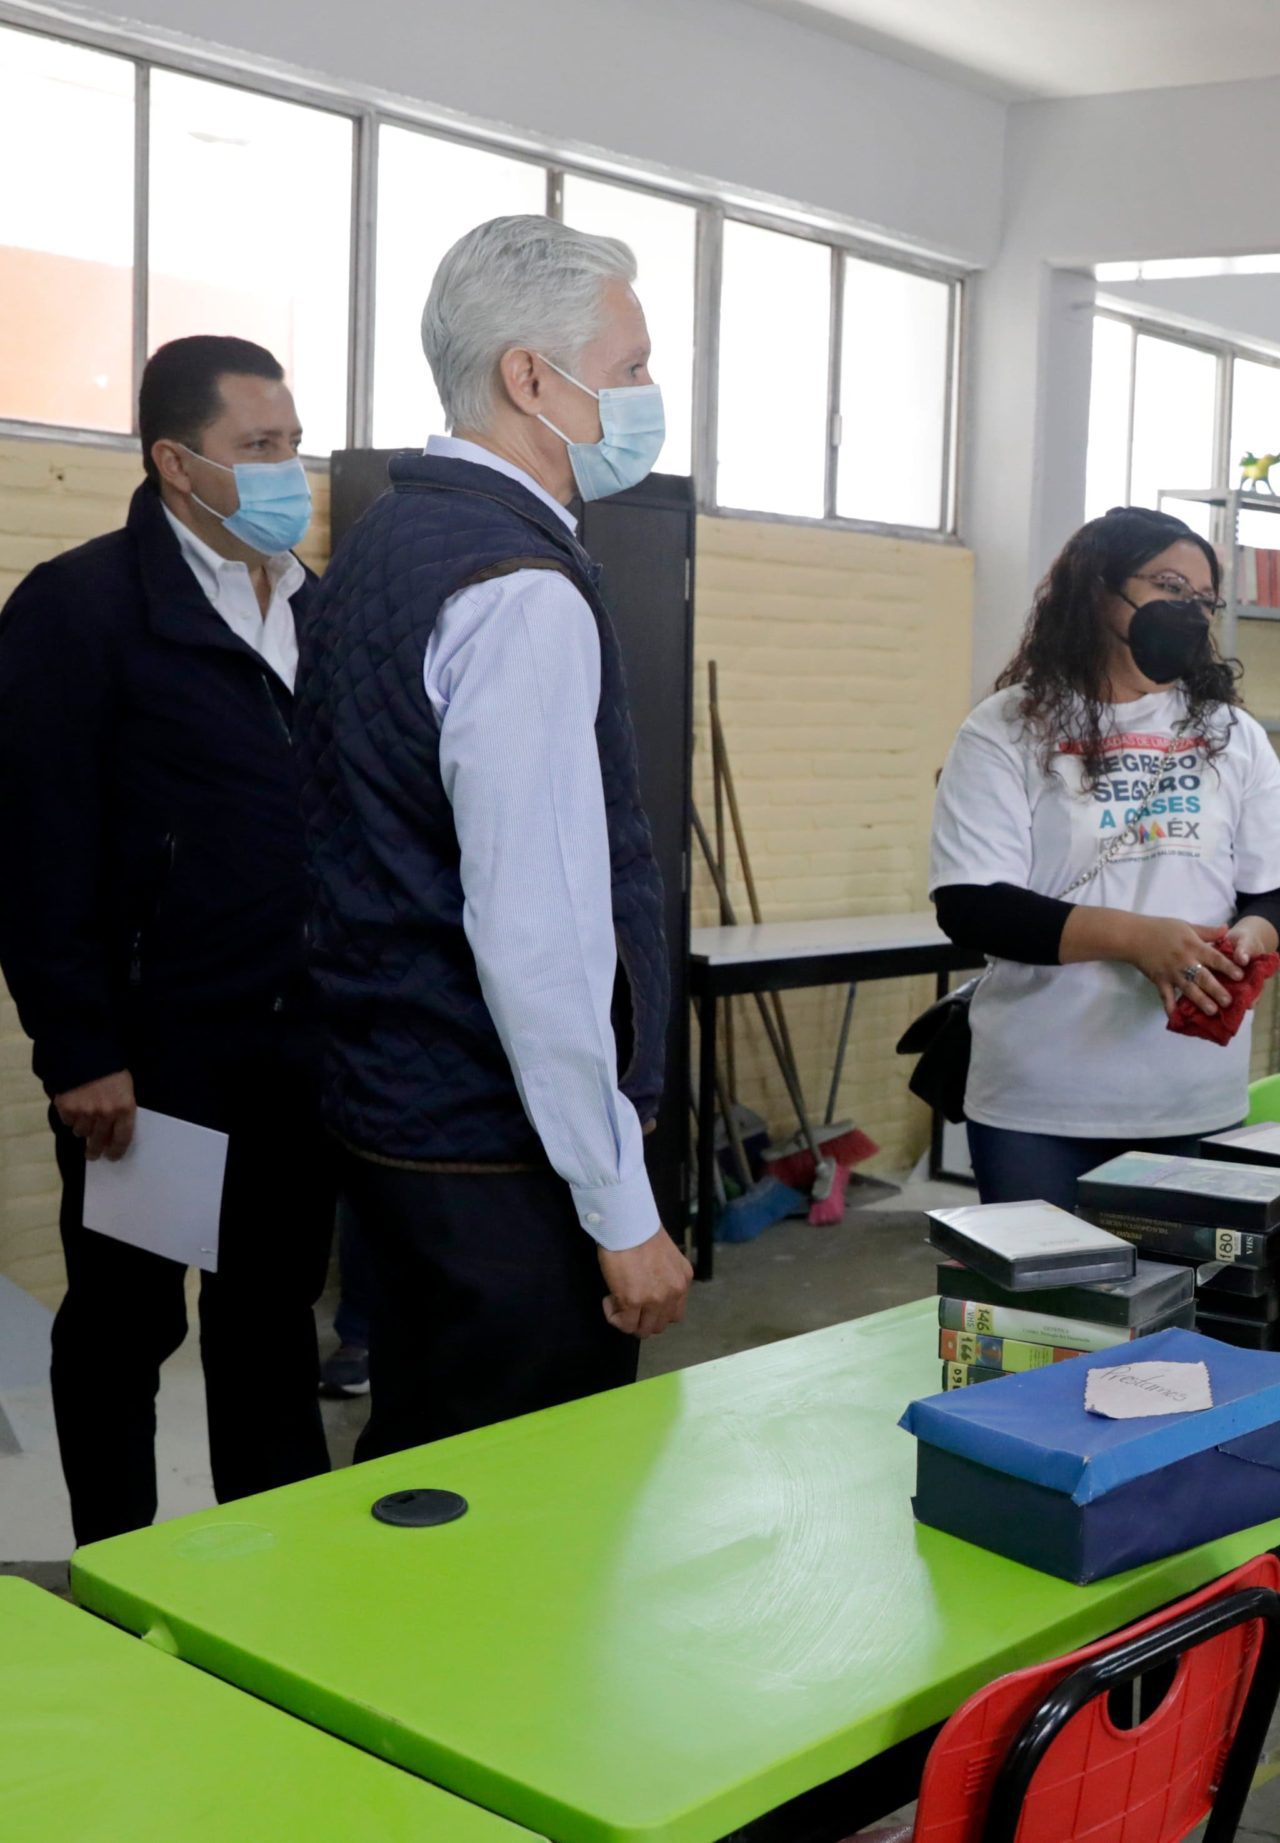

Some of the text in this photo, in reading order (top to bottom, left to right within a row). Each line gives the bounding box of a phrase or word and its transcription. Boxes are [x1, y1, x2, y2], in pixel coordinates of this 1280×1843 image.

[1101, 753, 1197, 775] EGRESO
[1093, 775, 1201, 803] SEGRO
[1100, 796, 1201, 828] A CASES
[1219, 1233, 1233, 1259] 180
[977, 1308, 990, 1332] 146
[960, 1336, 973, 1361] 166
